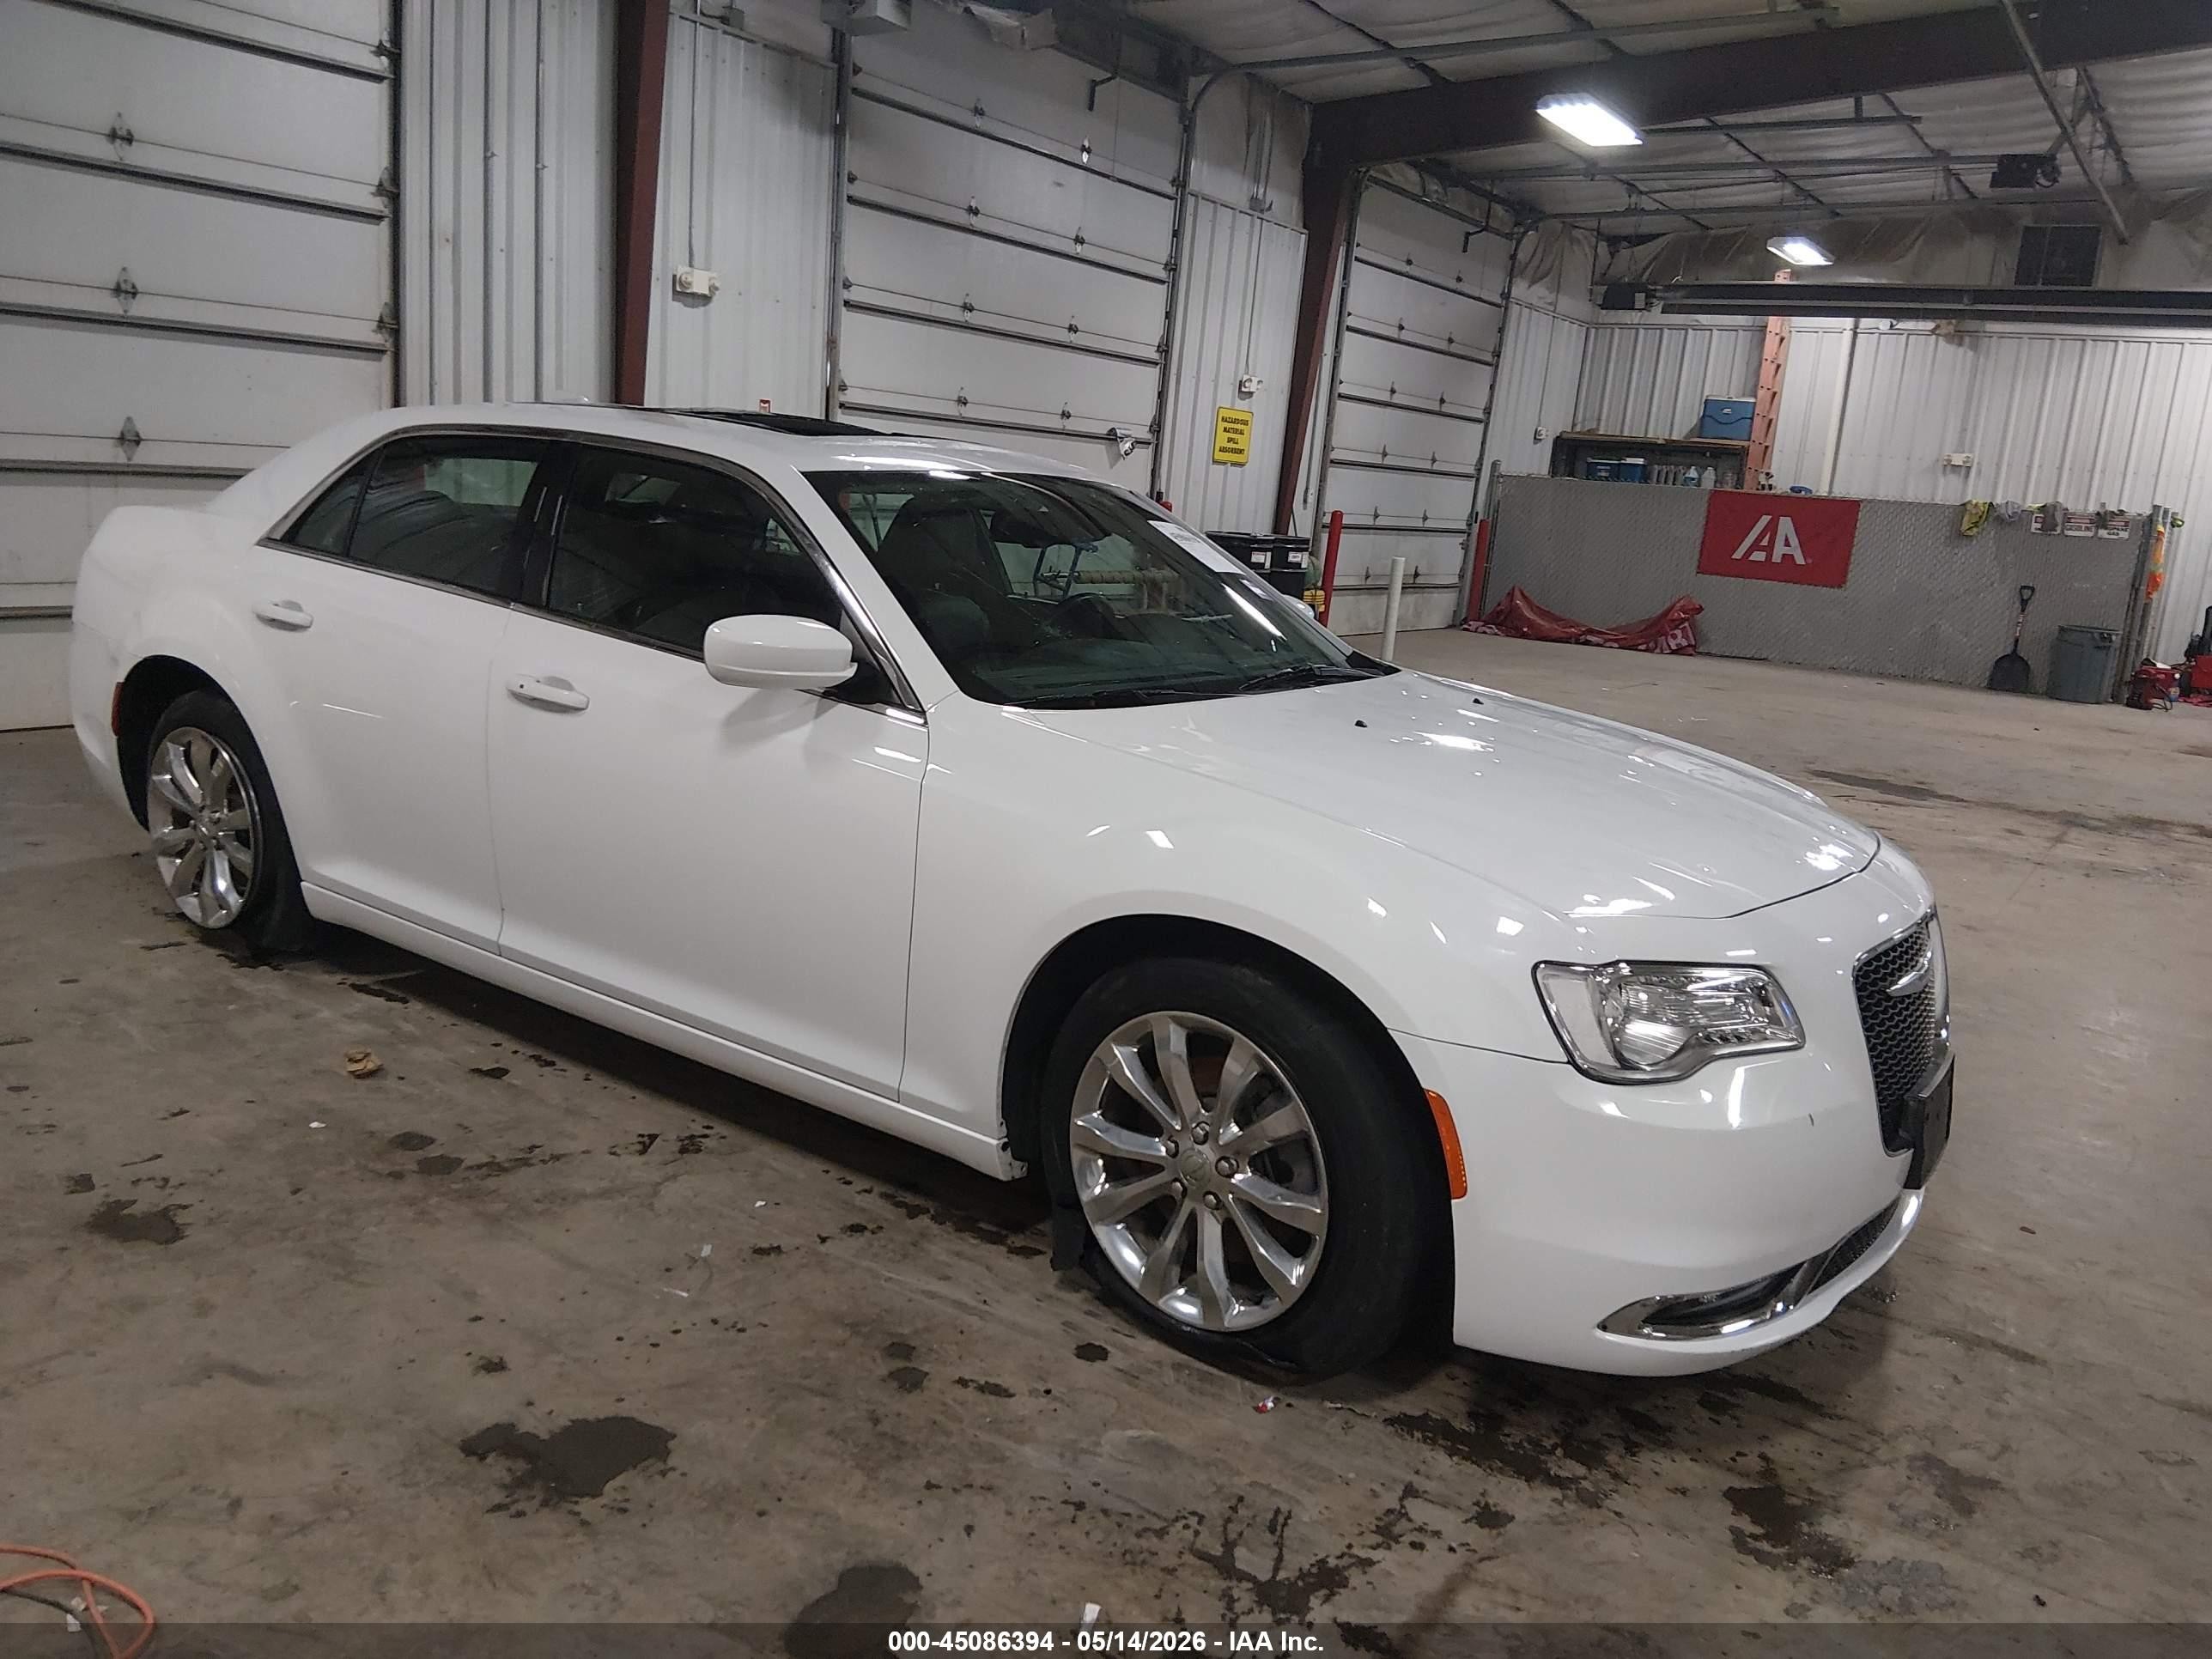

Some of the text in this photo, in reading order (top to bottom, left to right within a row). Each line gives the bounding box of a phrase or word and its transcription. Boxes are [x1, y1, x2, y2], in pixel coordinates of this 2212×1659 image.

[1221, 416, 1249, 426] HAZARDOUS
[1223, 426, 1244, 435] MATERIAL
[1227, 436, 1239, 445] SPILL
[1218, 446, 1245, 455] ABSORBENT
